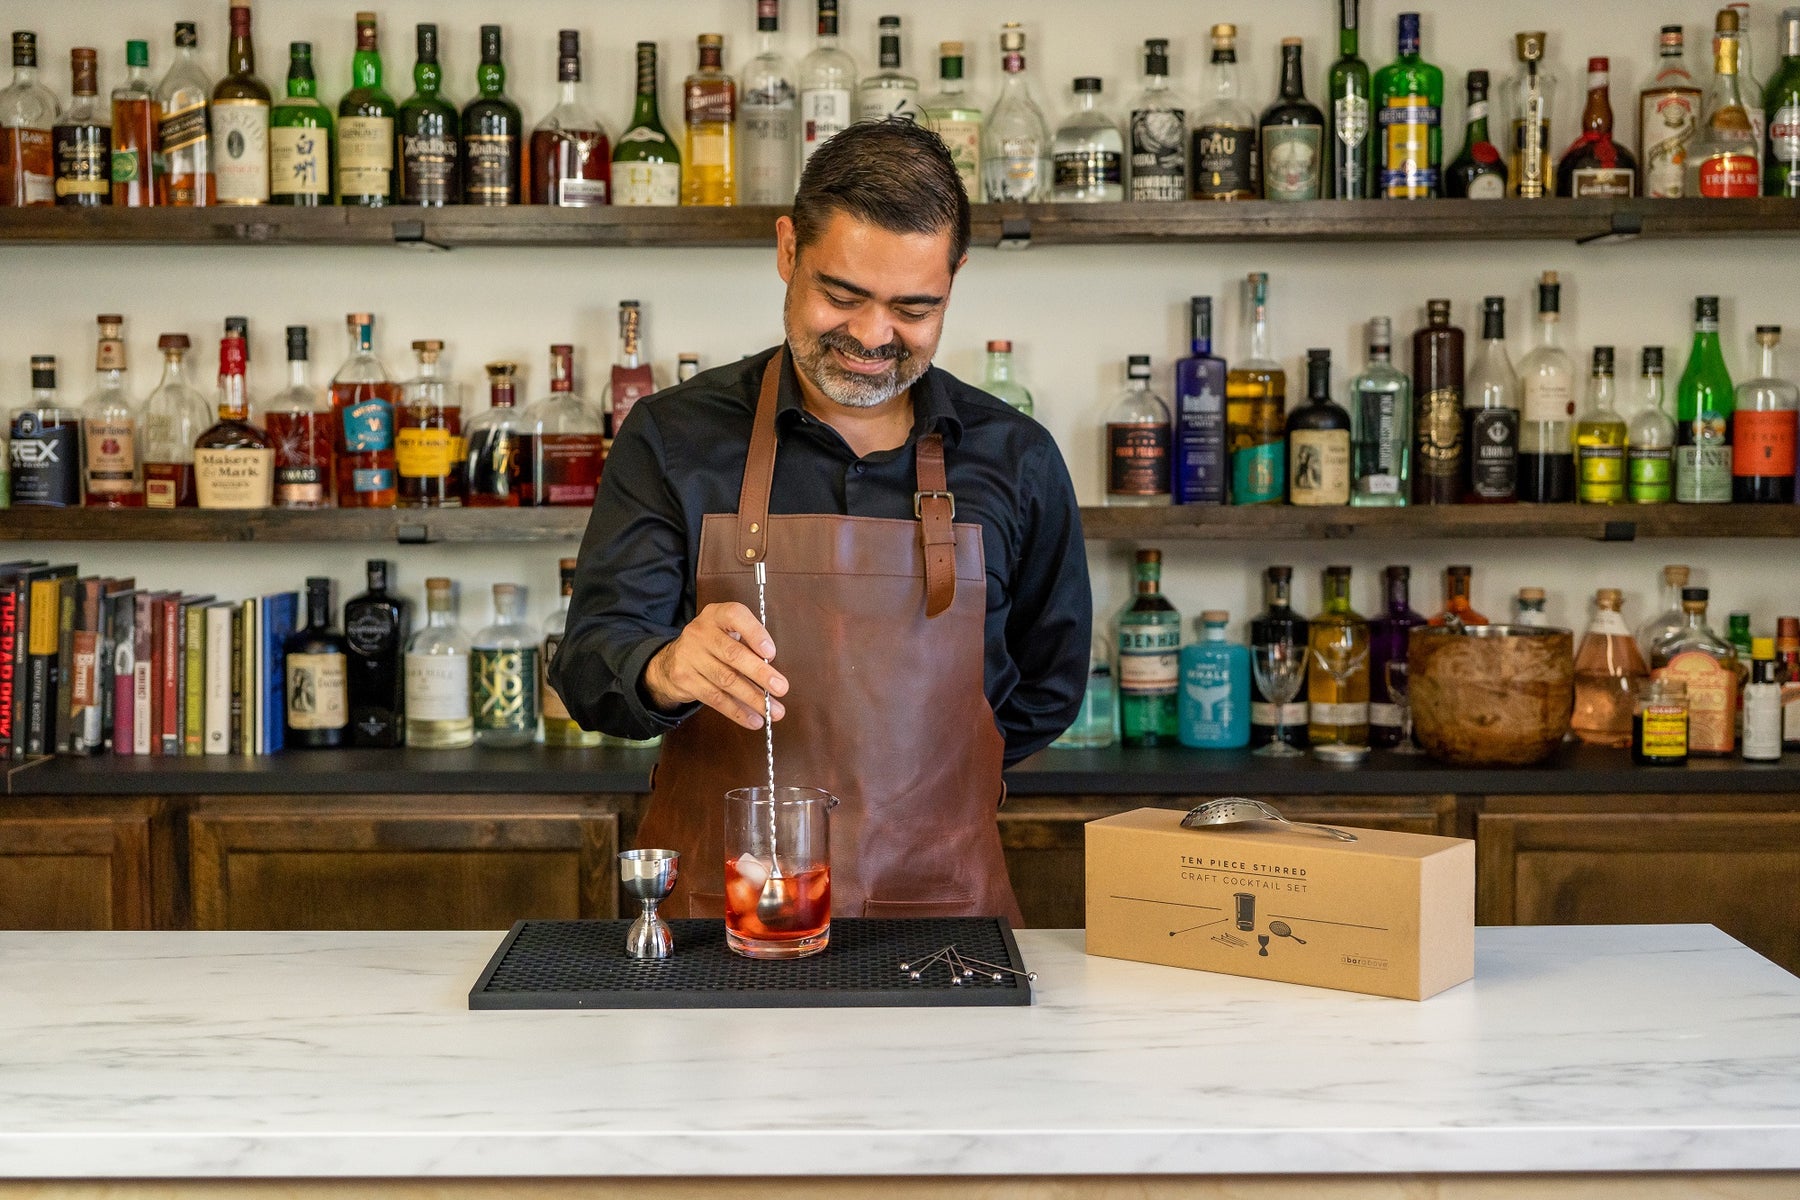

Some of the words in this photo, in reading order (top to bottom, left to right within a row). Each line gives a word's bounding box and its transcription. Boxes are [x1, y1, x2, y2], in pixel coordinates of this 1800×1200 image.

[202, 454, 260, 466] Maker's
[219, 467, 259, 477] Mark
[1186, 670, 1230, 681] WHALE
[1181, 856, 1203, 866] TEN
[1210, 859, 1246, 870] PIECE
[1253, 864, 1307, 877] STIRRED
[1181, 871, 1218, 884] CRAFT
[1222, 876, 1281, 891] COCKTAIL
[1287, 883, 1308, 894] SET
